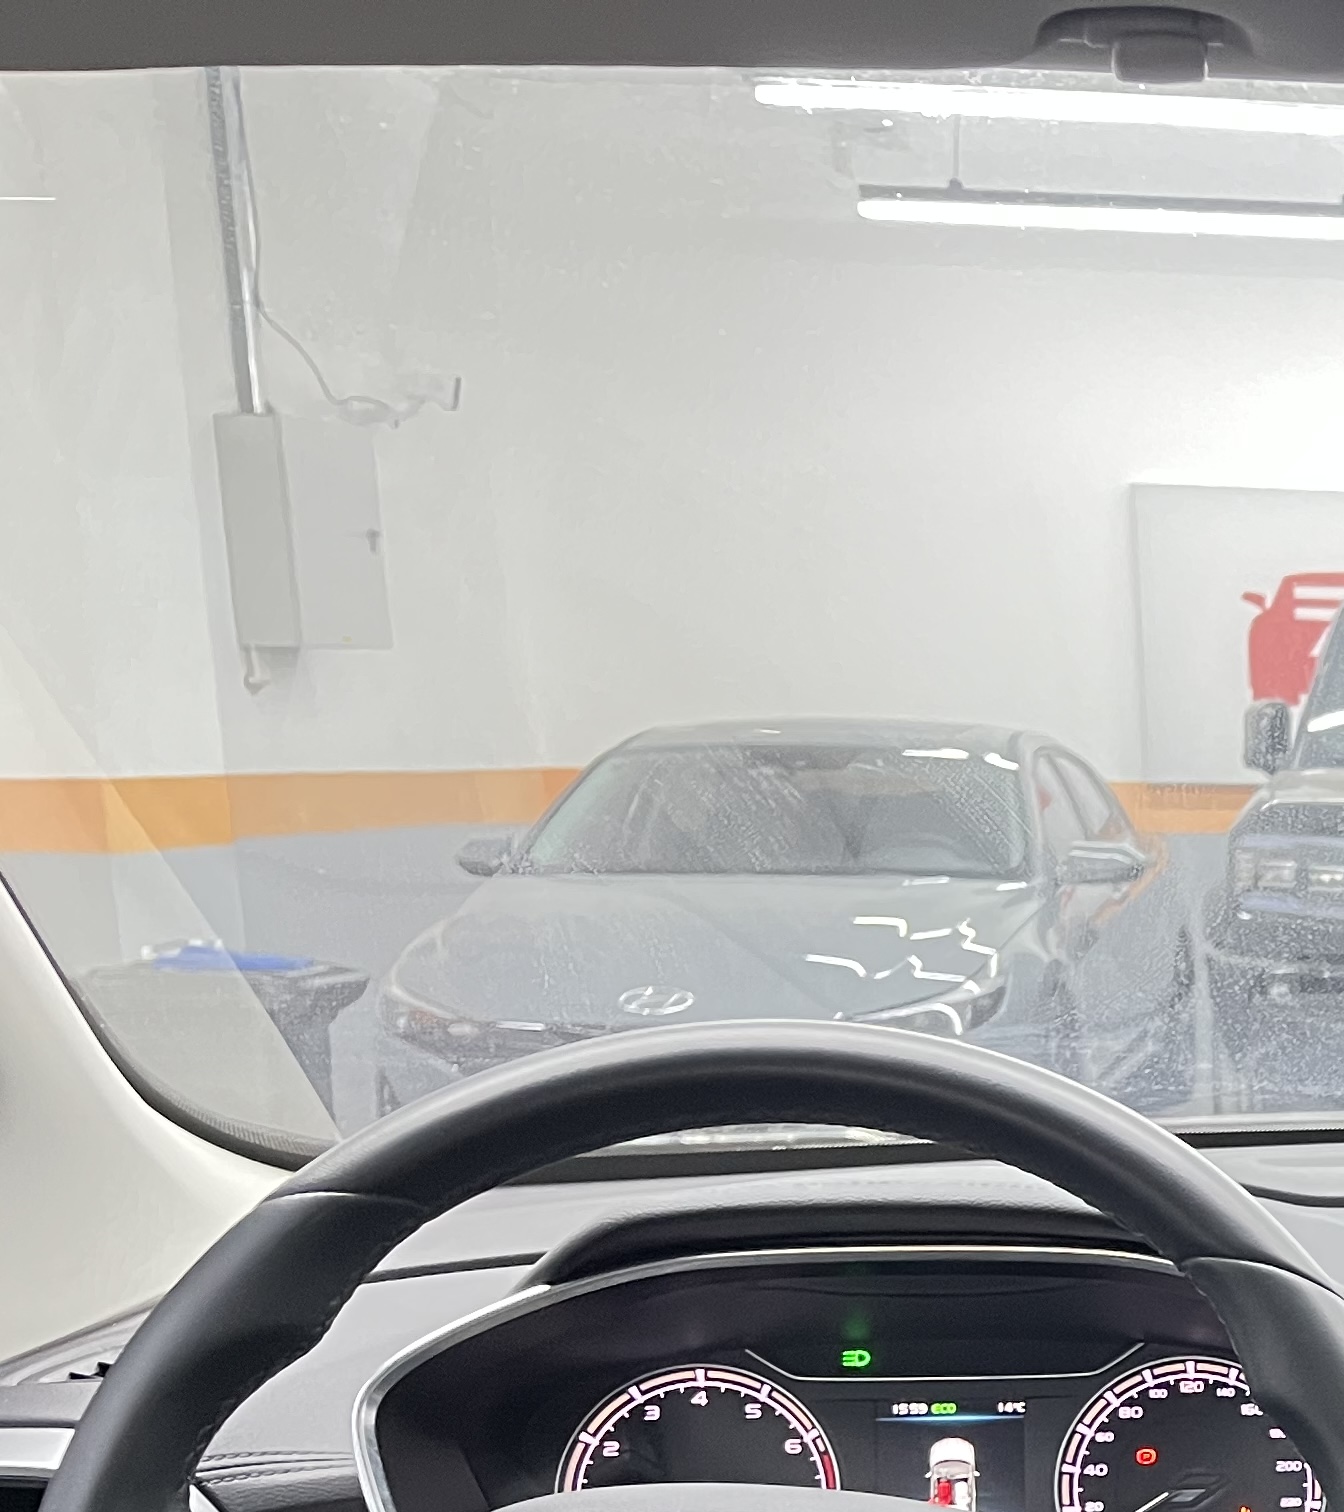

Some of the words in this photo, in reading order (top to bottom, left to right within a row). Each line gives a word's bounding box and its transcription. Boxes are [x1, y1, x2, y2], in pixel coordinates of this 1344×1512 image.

[690, 1390, 709, 1407] 4
[643, 1404, 661, 1421] 3
[744, 1403, 763, 1420] 5
[931, 1402, 957, 1415] ECO
[602, 1440, 620, 1457] 2
[784, 1438, 803, 1455] 6
[1083, 1464, 1109, 1477] 40
[1275, 1460, 1303, 1473] 200
